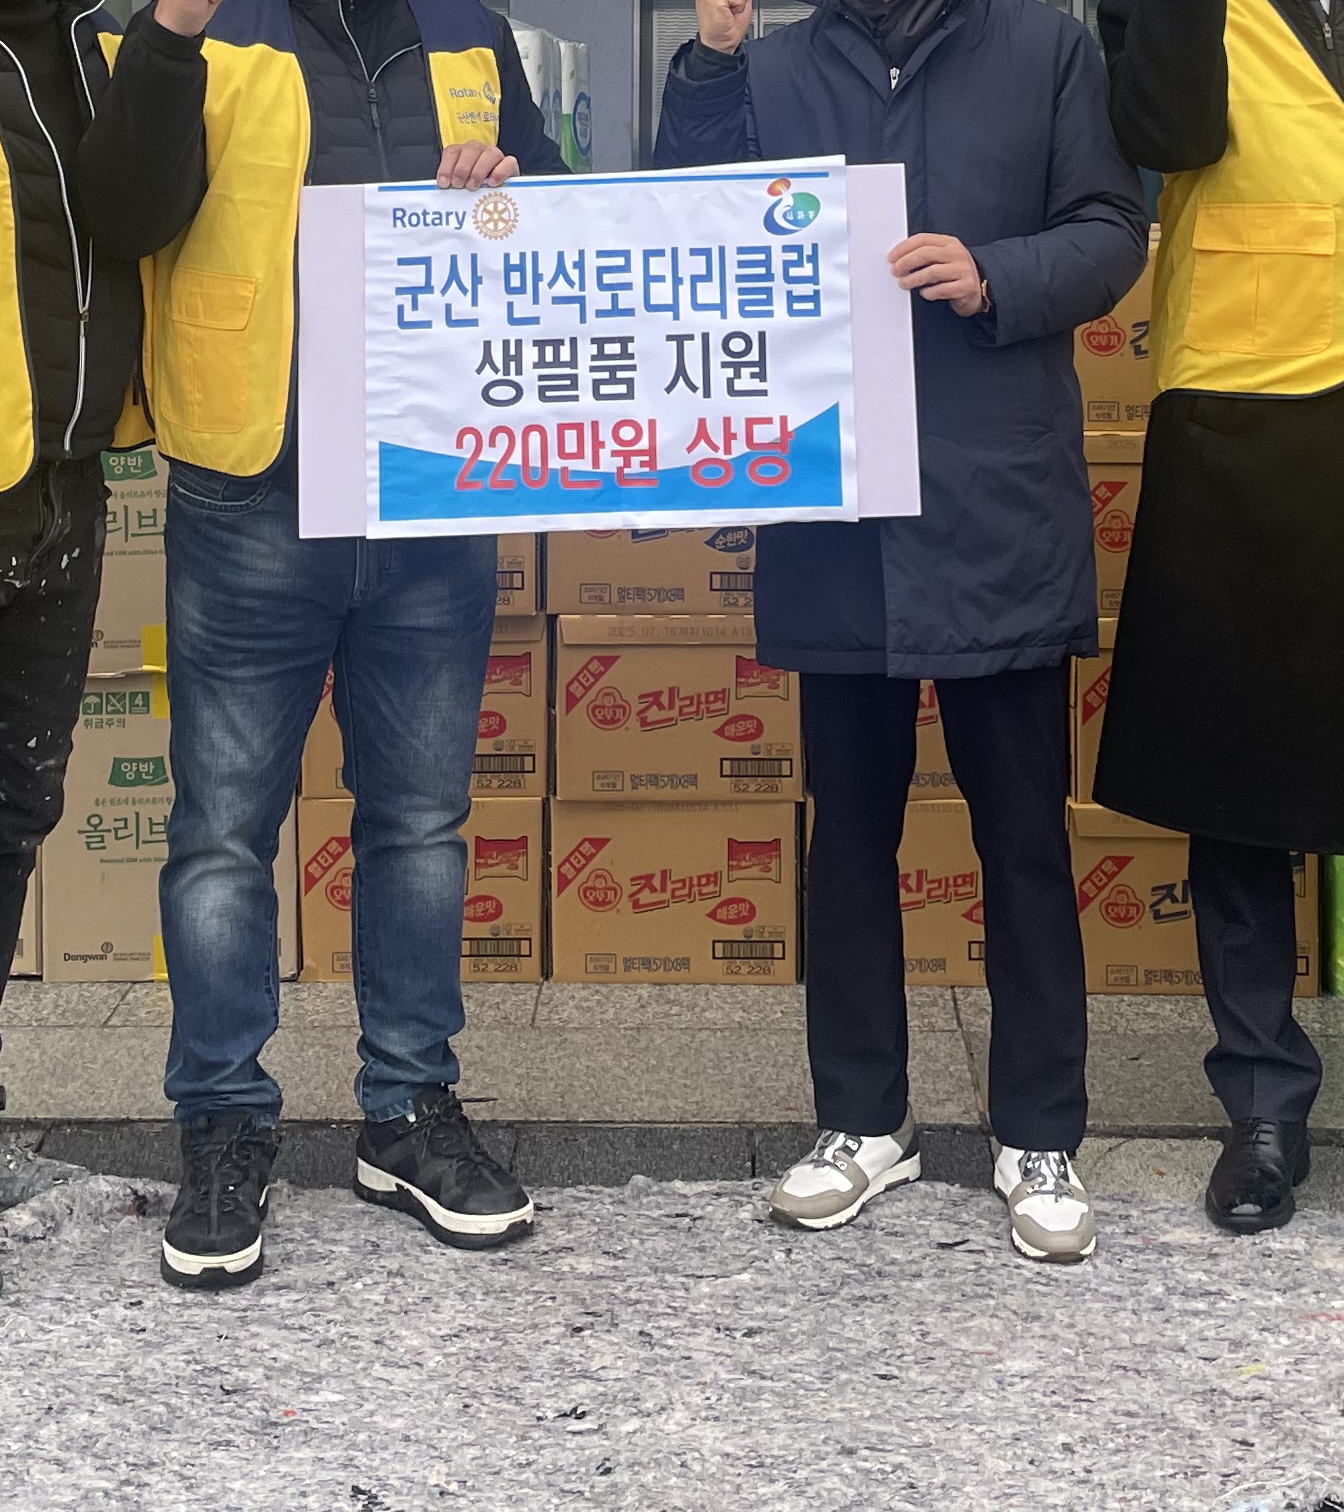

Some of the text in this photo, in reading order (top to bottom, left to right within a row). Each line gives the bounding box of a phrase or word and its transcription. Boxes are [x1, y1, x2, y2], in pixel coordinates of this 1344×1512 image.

[392, 207, 467, 230] Rotary
[394, 242, 822, 330] 군산 반석로타리클럽
[475, 330, 769, 408] 생필품 지원
[109, 455, 143, 475] 양반
[455, 414, 795, 491] 220만원 상당
[106, 504, 166, 543] 리브
[715, 530, 748, 550] 순한맛
[478, 715, 500, 734] 운맛
[636, 686, 730, 732] 진라면
[120, 761, 155, 780] 양반
[78, 811, 169, 851] 올리브
[628, 868, 722, 914] 진라면
